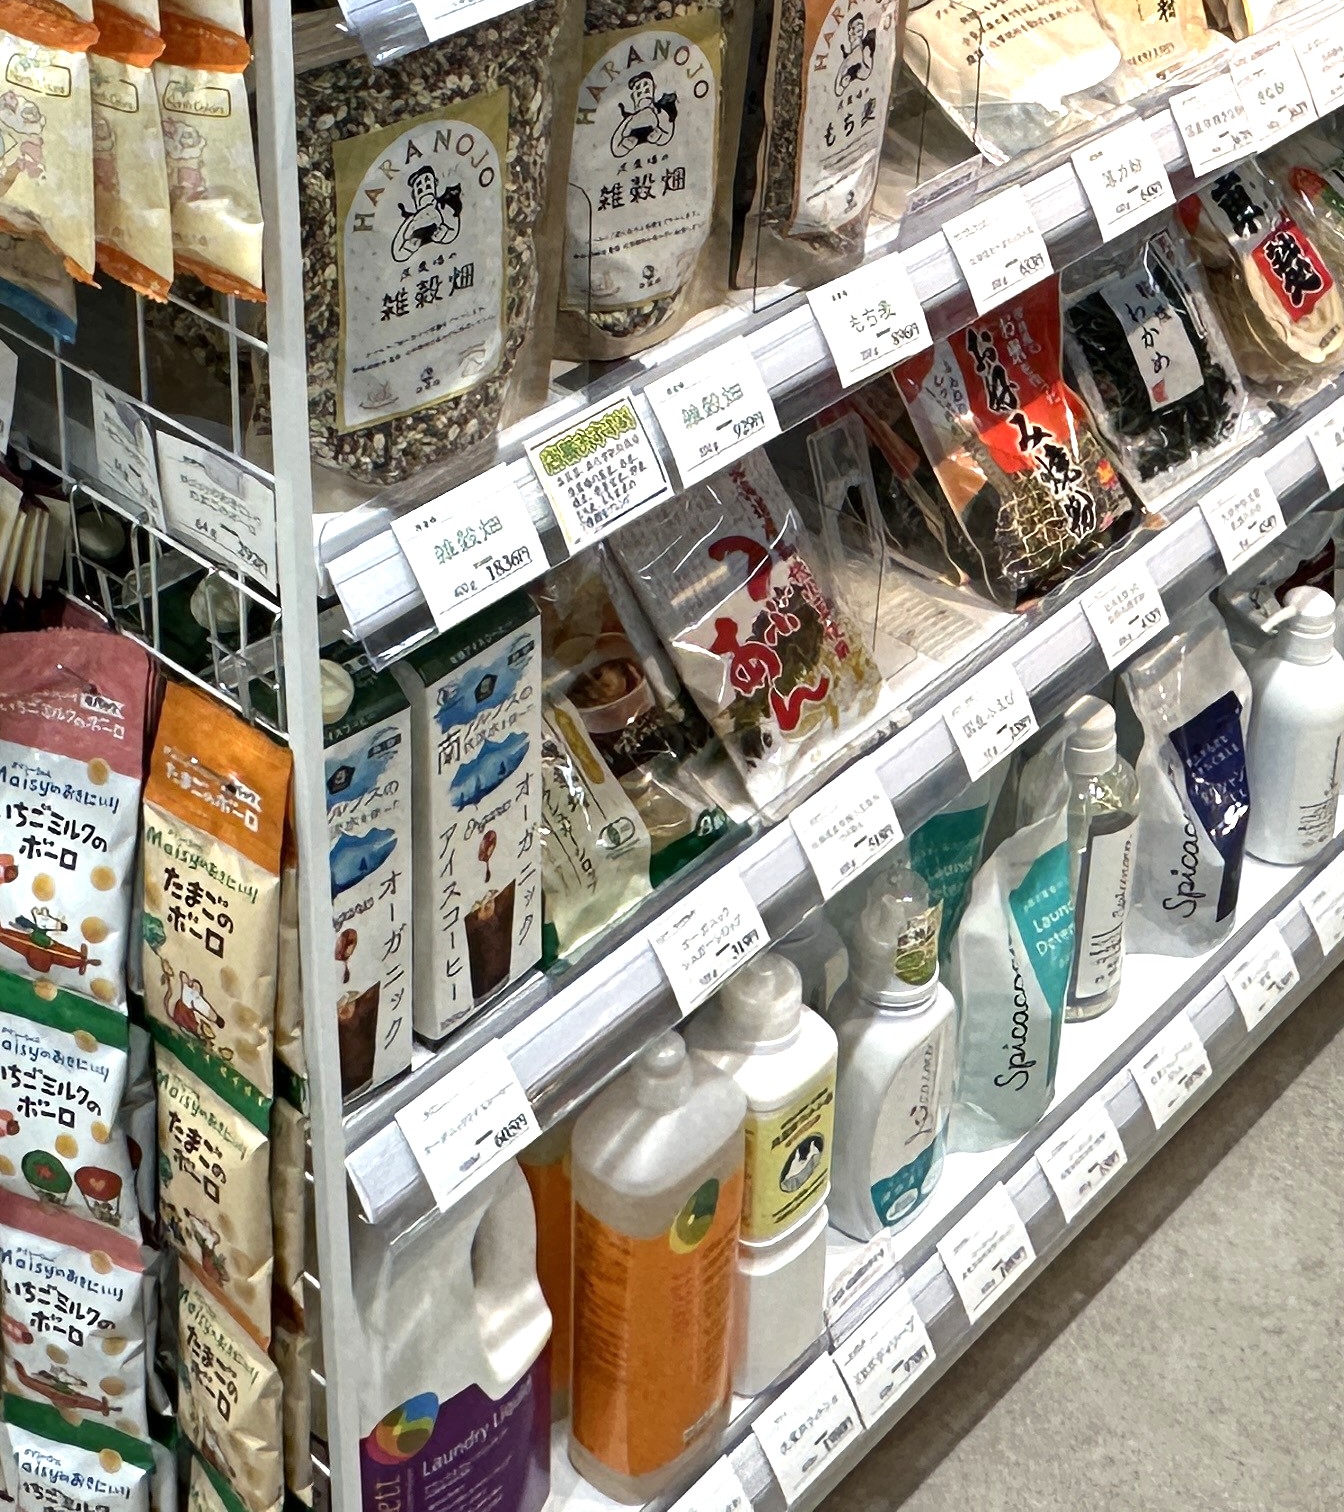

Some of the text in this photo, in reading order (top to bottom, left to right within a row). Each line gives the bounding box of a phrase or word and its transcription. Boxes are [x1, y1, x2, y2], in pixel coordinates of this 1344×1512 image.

[577, 39, 710, 127] HARANOJO
[352, 128, 495, 234] HARANOJO
[597, 166, 687, 212] 雑穀畑
[381, 262, 476, 322] 雑穀畑
[18, 835, 78, 871] ボーロ
[516, 772, 537, 947] オーガニック
[163, 866, 234, 934] たまごの
[438, 823, 462, 1001] アイスコーヒー
[166, 905, 225, 959] ボーロ
[379, 870, 408, 1050] オーガニック
[17, 1095, 76, 1129] ボーロ
[2, 1278, 116, 1331] いちごミルクの
[30, 1311, 84, 1348] ボーロ
[420, 1421, 491, 1479] Laundry
